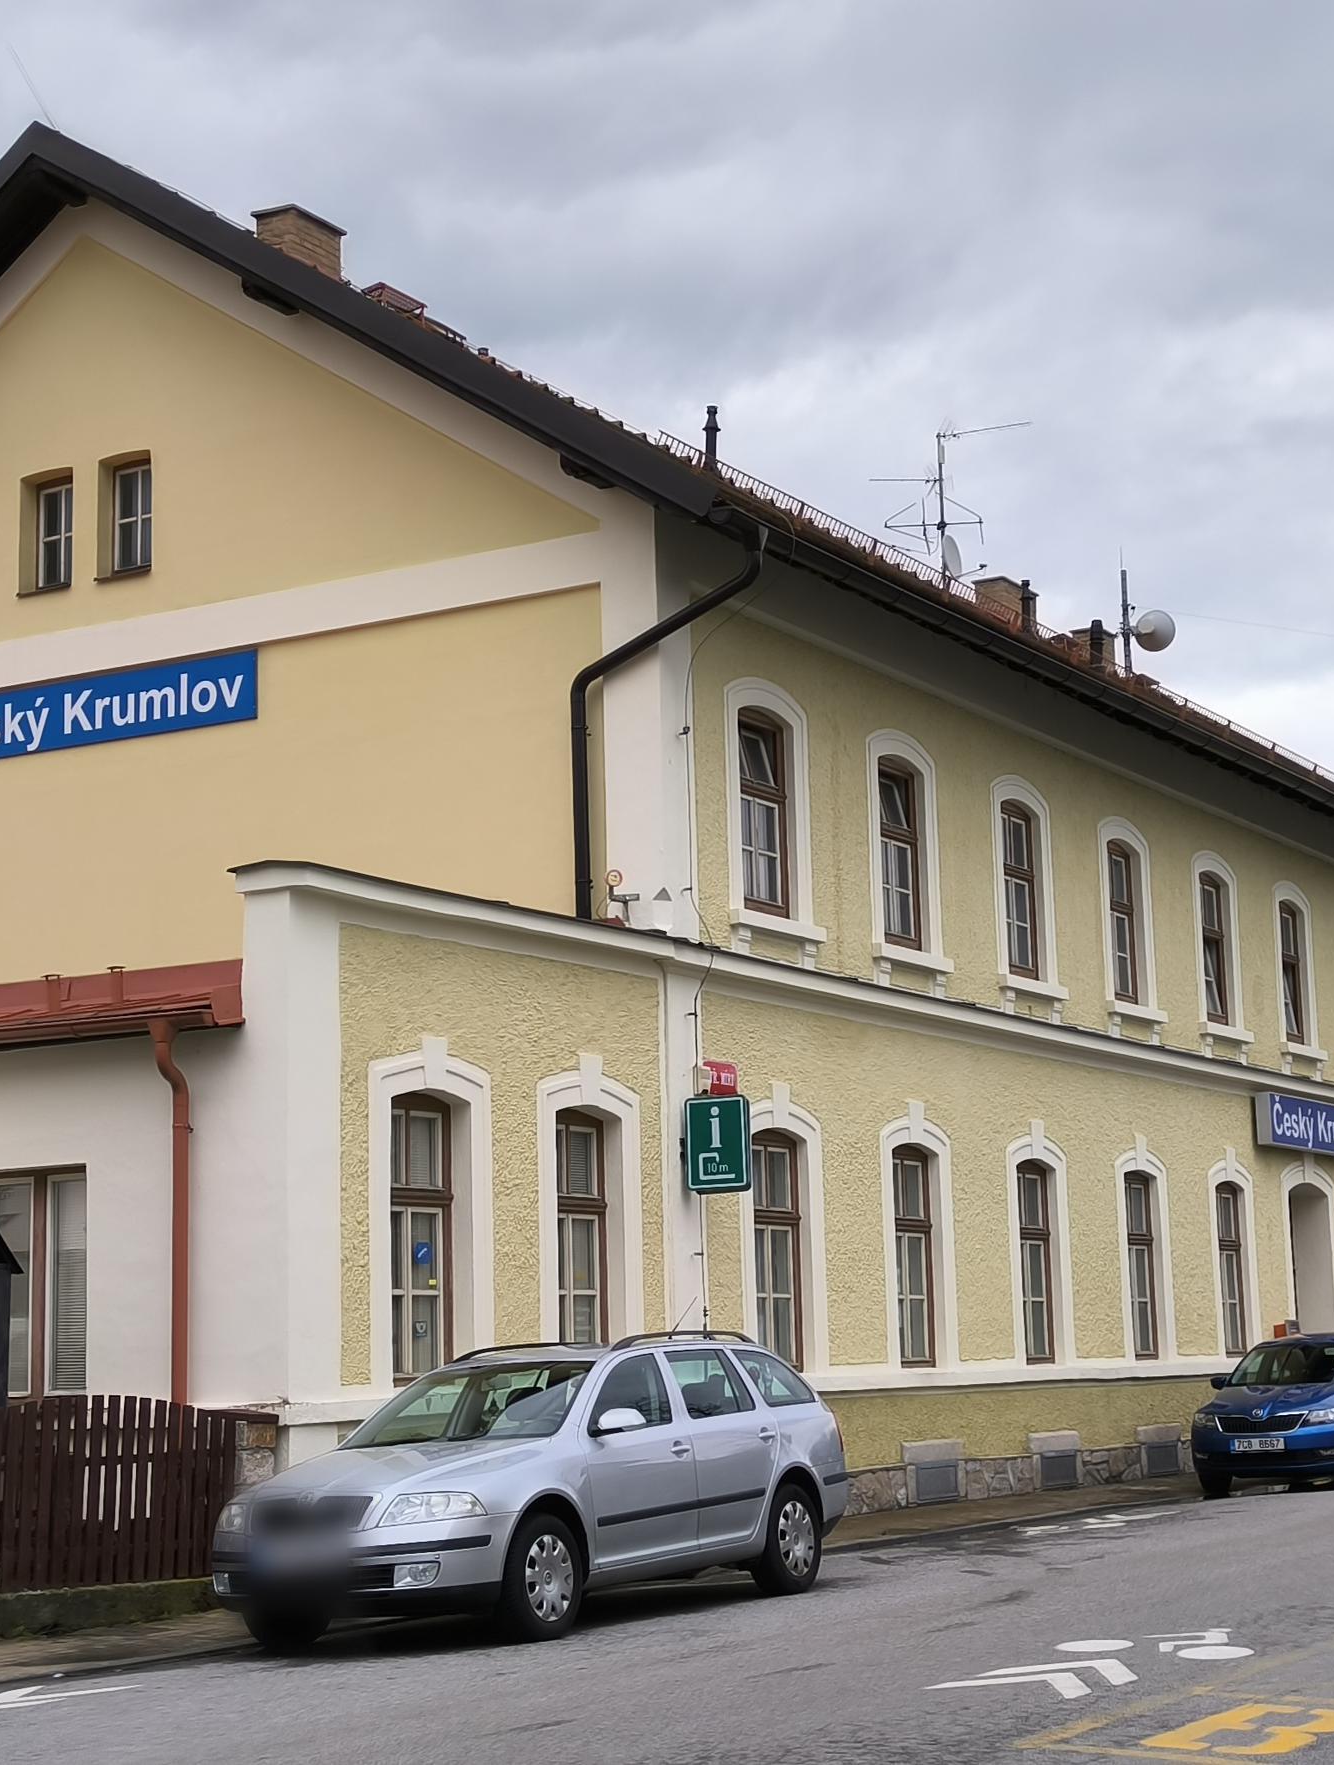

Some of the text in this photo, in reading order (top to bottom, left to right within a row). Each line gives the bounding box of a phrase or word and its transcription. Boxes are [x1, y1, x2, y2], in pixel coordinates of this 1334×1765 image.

[63, 673, 244, 735] Krumlov
[1273, 1095, 1314, 1149] Český
[707, 1163, 729, 1173] 10 m
